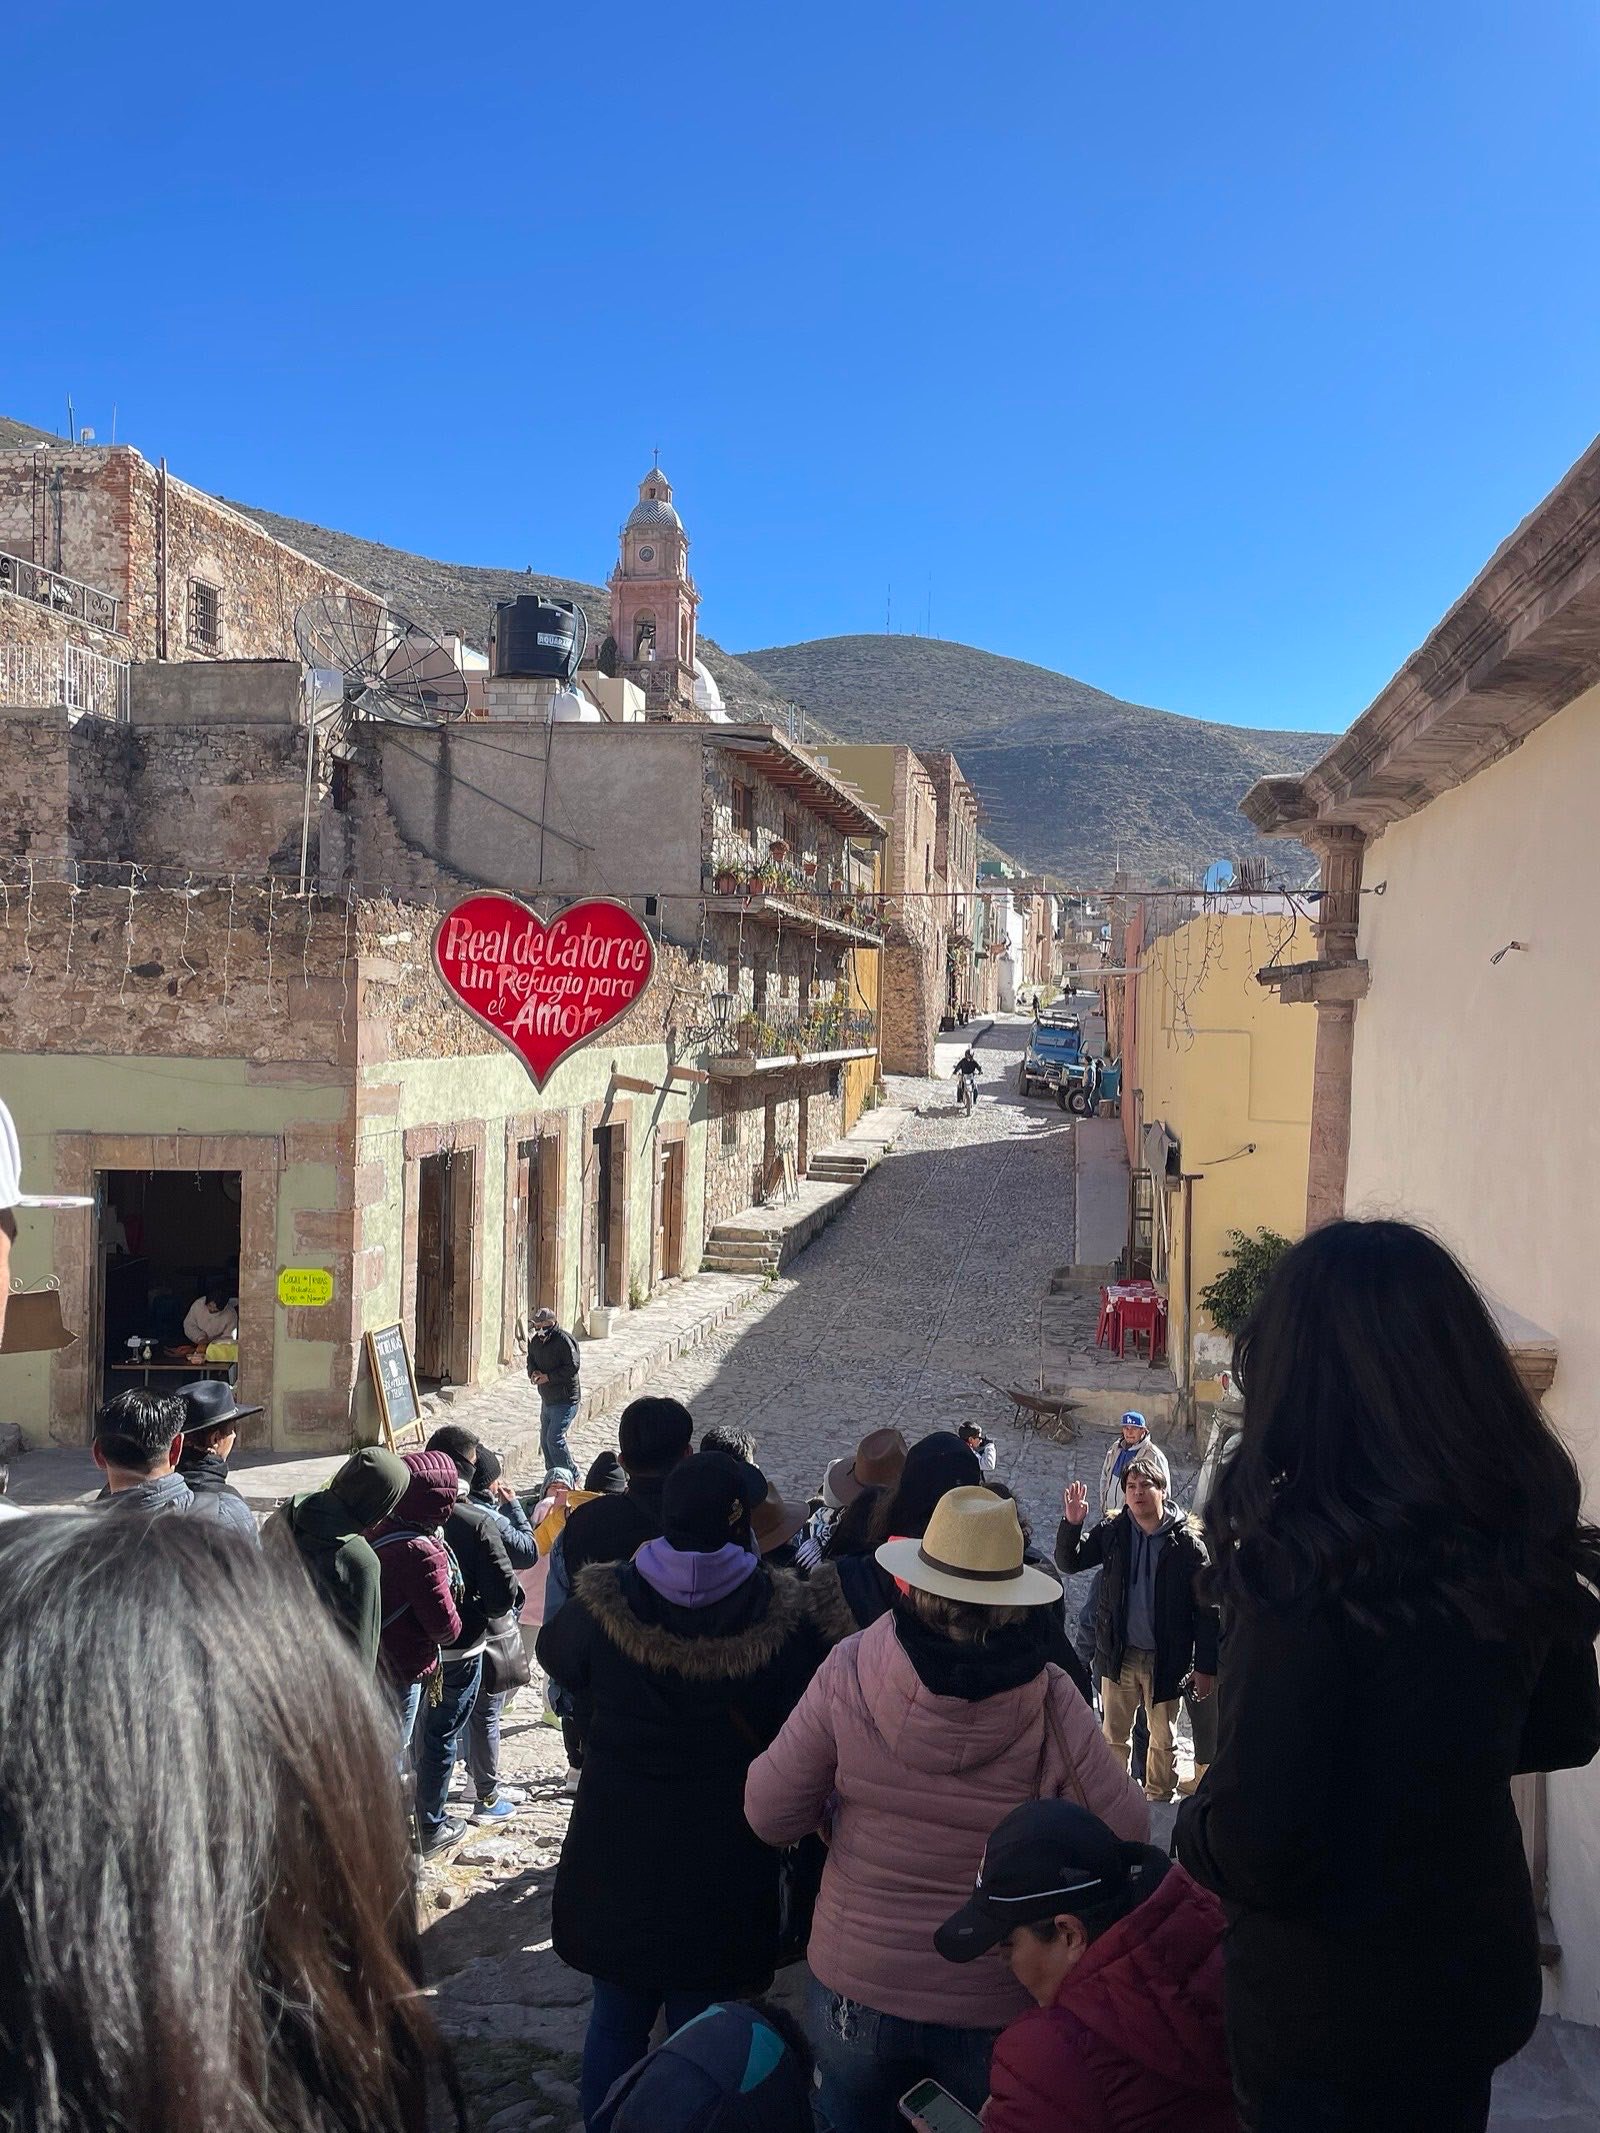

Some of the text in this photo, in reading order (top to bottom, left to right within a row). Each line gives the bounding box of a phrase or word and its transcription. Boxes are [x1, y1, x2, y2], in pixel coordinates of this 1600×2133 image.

[445, 917, 648, 971] Real de Catorce
[497, 964, 584, 1004] Refugio
[583, 976, 635, 1005] para
[487, 994, 604, 1038] el Amor
